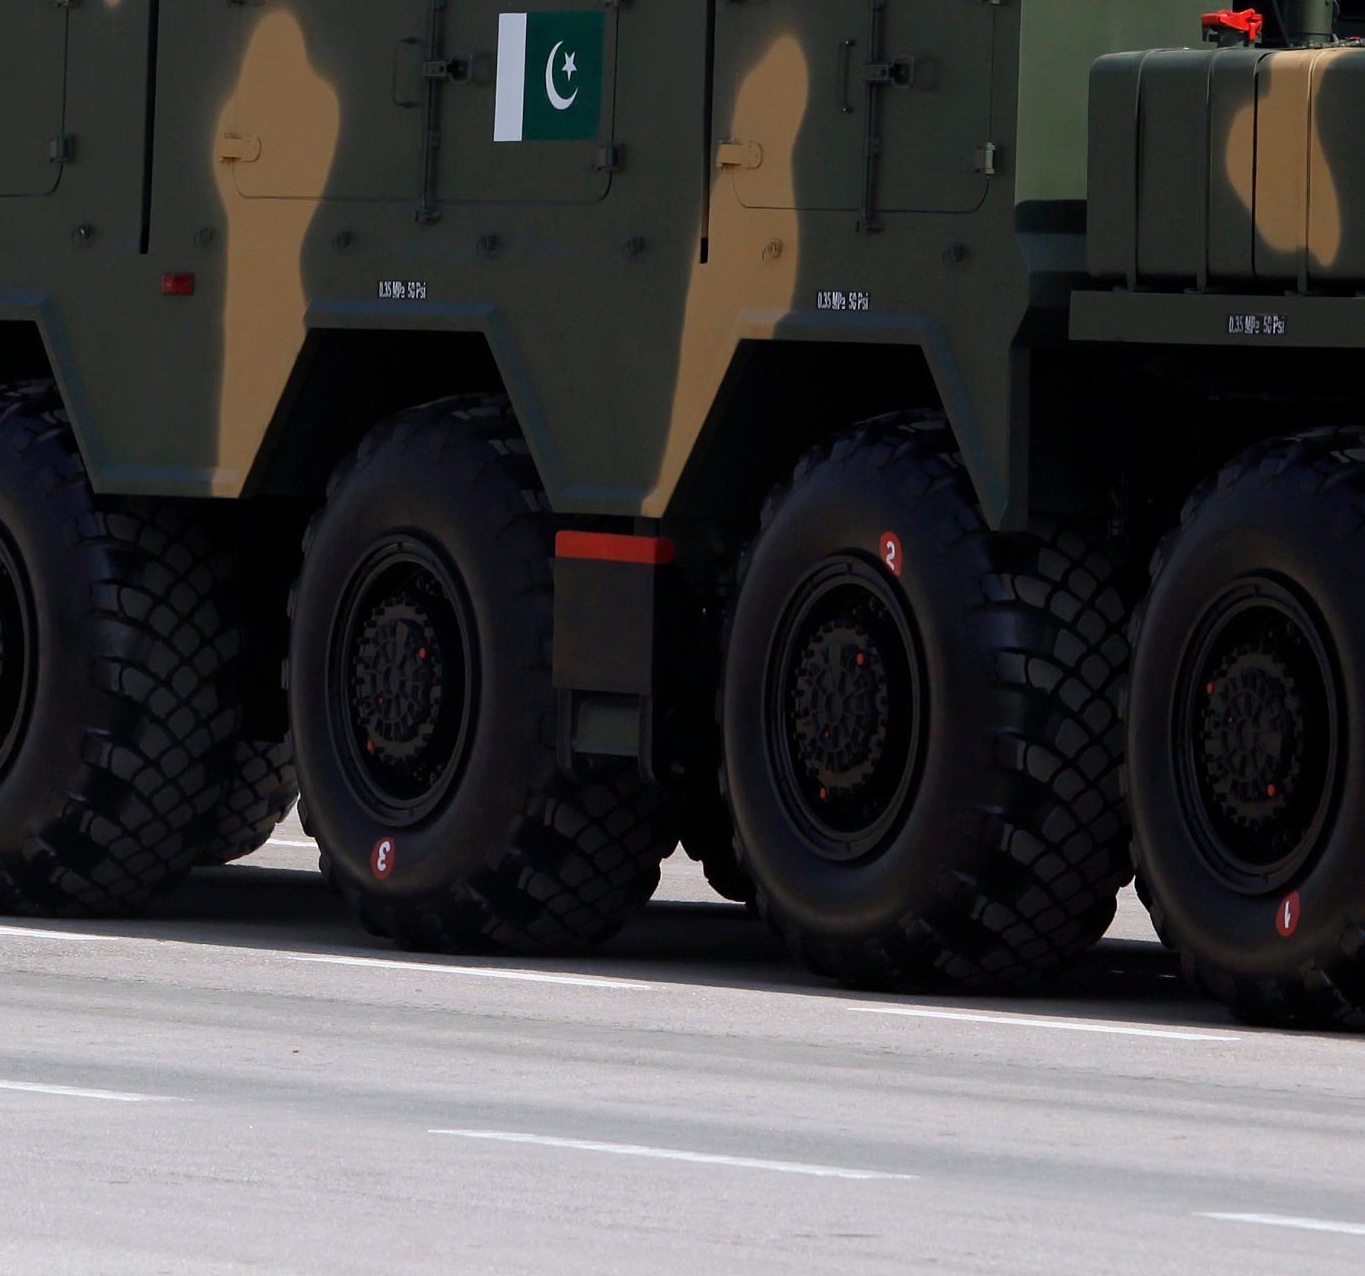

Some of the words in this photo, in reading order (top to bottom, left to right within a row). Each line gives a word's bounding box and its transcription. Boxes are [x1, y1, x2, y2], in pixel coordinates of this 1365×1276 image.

[886, 541, 896, 571] 2
[377, 841, 391, 872] 3
[1284, 900, 1291, 929] 1
